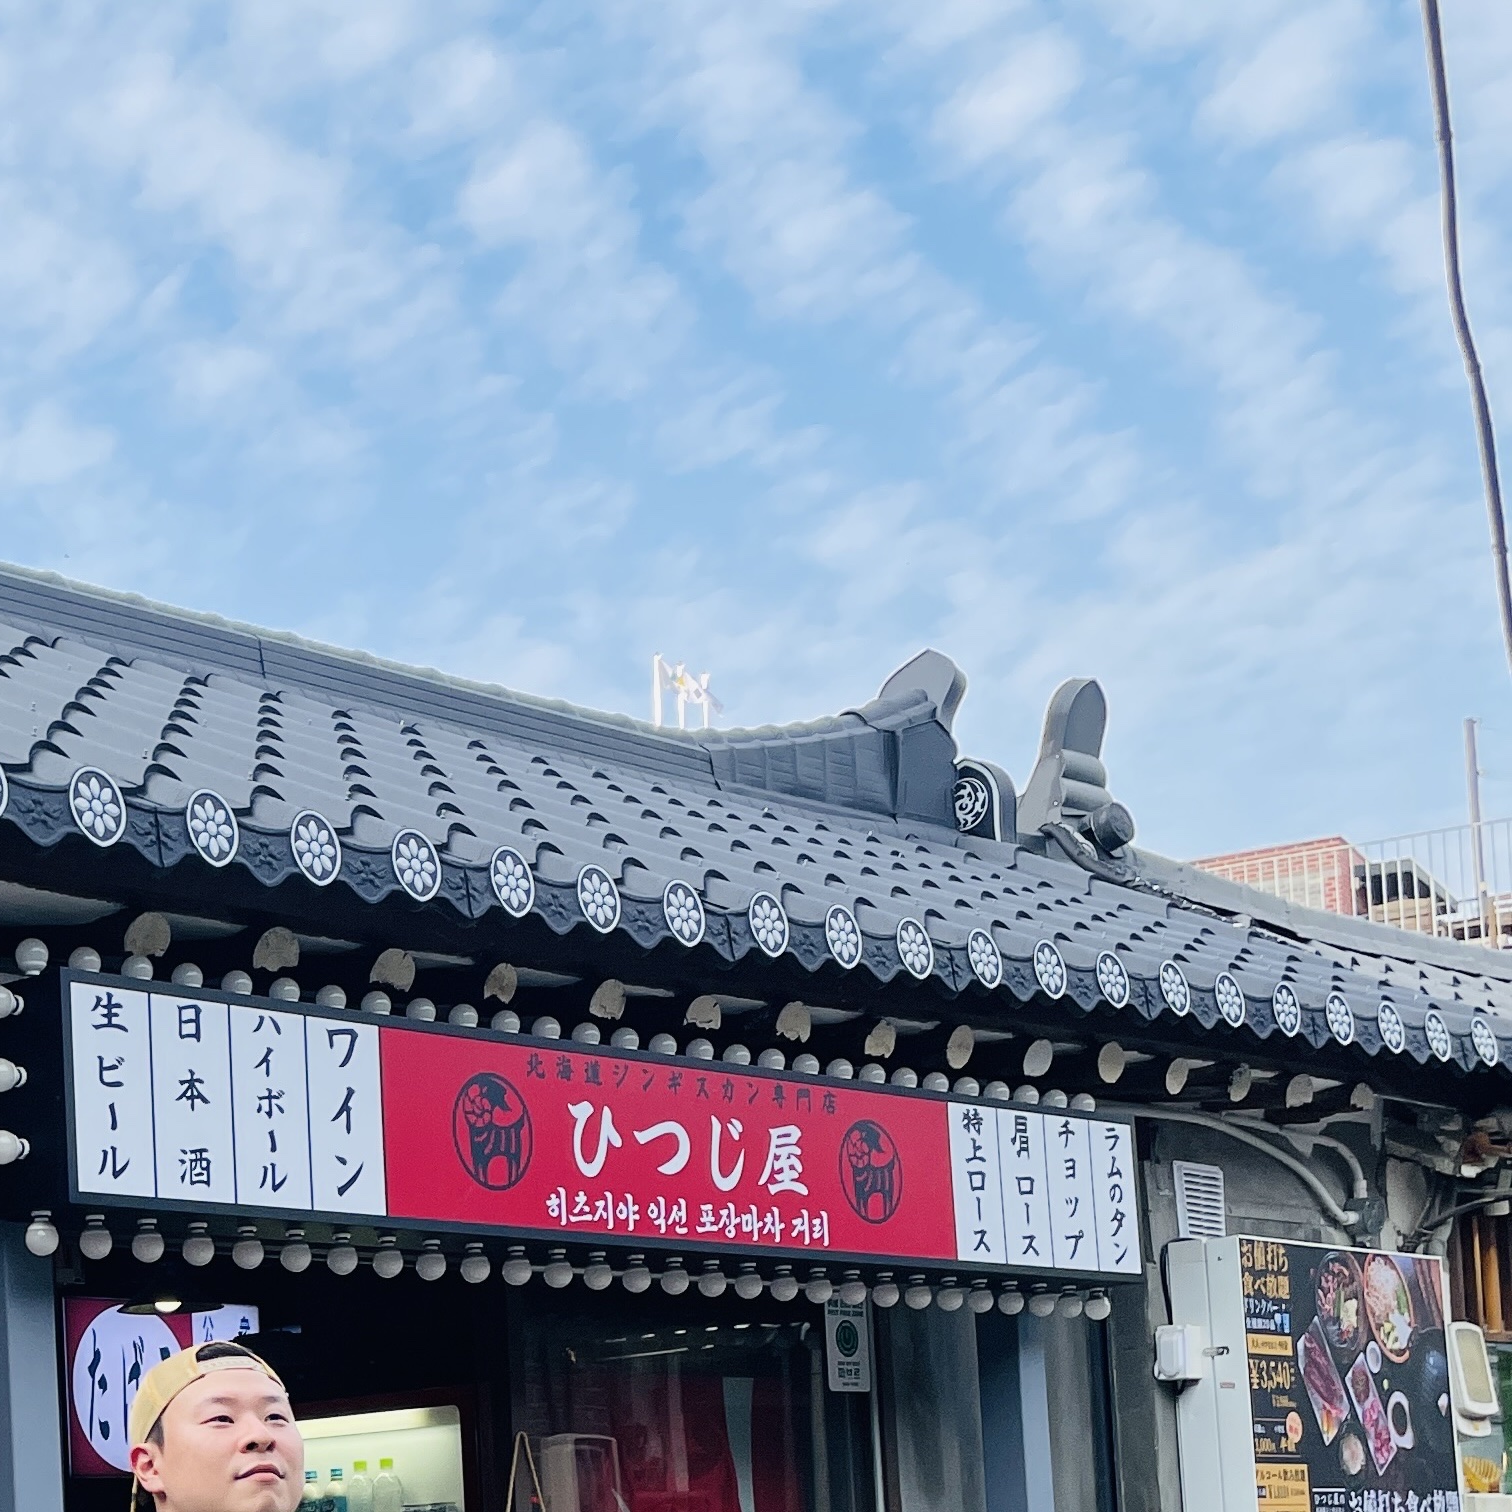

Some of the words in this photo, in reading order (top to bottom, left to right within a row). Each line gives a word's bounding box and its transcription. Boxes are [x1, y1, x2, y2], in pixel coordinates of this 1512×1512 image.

[90, 992, 130, 1181] 生ビール
[175, 1004, 212, 1189] 日本酒
[252, 1015, 288, 1194] ハイボール
[325, 1027, 365, 1197] ワイン
[526, 1052, 838, 1116] 北海道ジンギスカン専門店
[567, 1100, 810, 1198] ひつじ屋
[545, 1186, 640, 1232] 히츠지야
[647, 1196, 689, 1235] 익선
[695, 1202, 786, 1243] 포장마차
[791, 1208, 830, 1247] 거리
[962, 1108, 992, 1254] 特上ロース
[1011, 1114, 1041, 1258] 肩ロース
[1057, 1119, 1085, 1261] チョップ
[1103, 1126, 1130, 1266] ラムのタン
